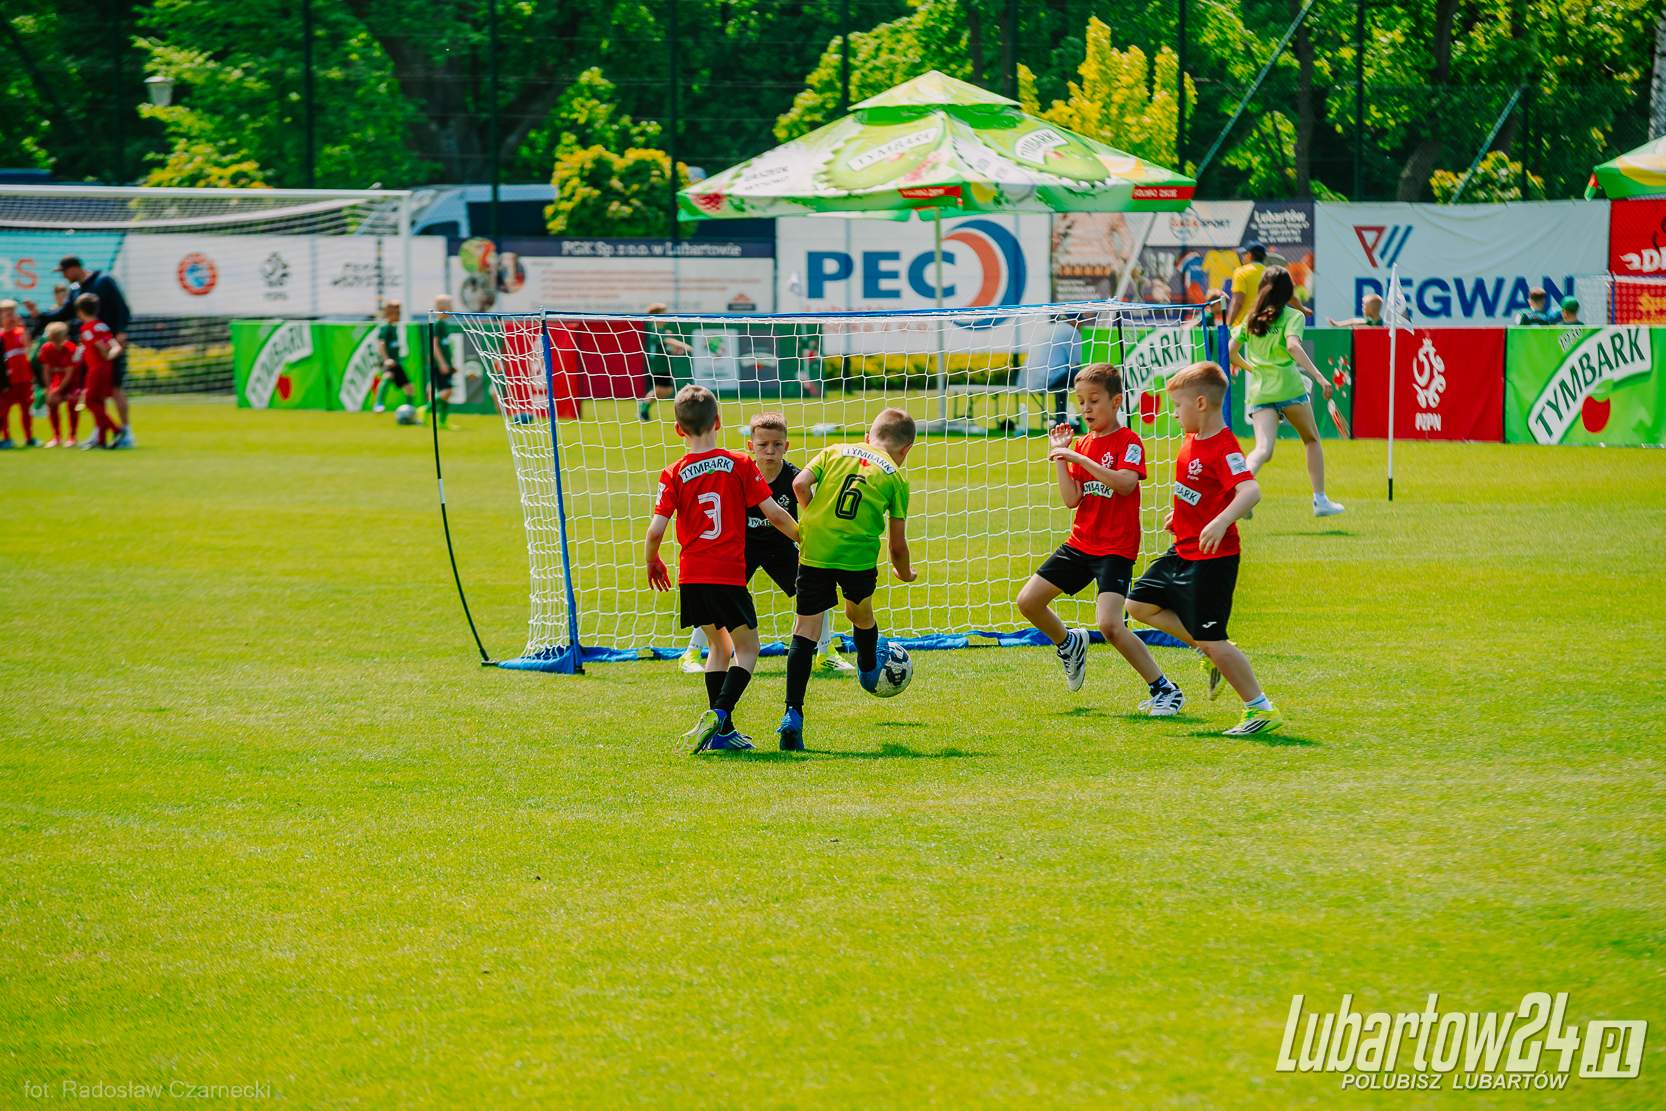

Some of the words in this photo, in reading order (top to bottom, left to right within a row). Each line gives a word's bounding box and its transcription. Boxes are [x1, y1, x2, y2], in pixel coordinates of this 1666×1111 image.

[807, 251, 957, 299] PEC
[1535, 328, 1646, 438] TYMBARK
[682, 457, 731, 479] TYMBARK
[846, 447, 893, 472] TYMBARK
[698, 491, 722, 540] 3
[835, 473, 867, 520] 6
